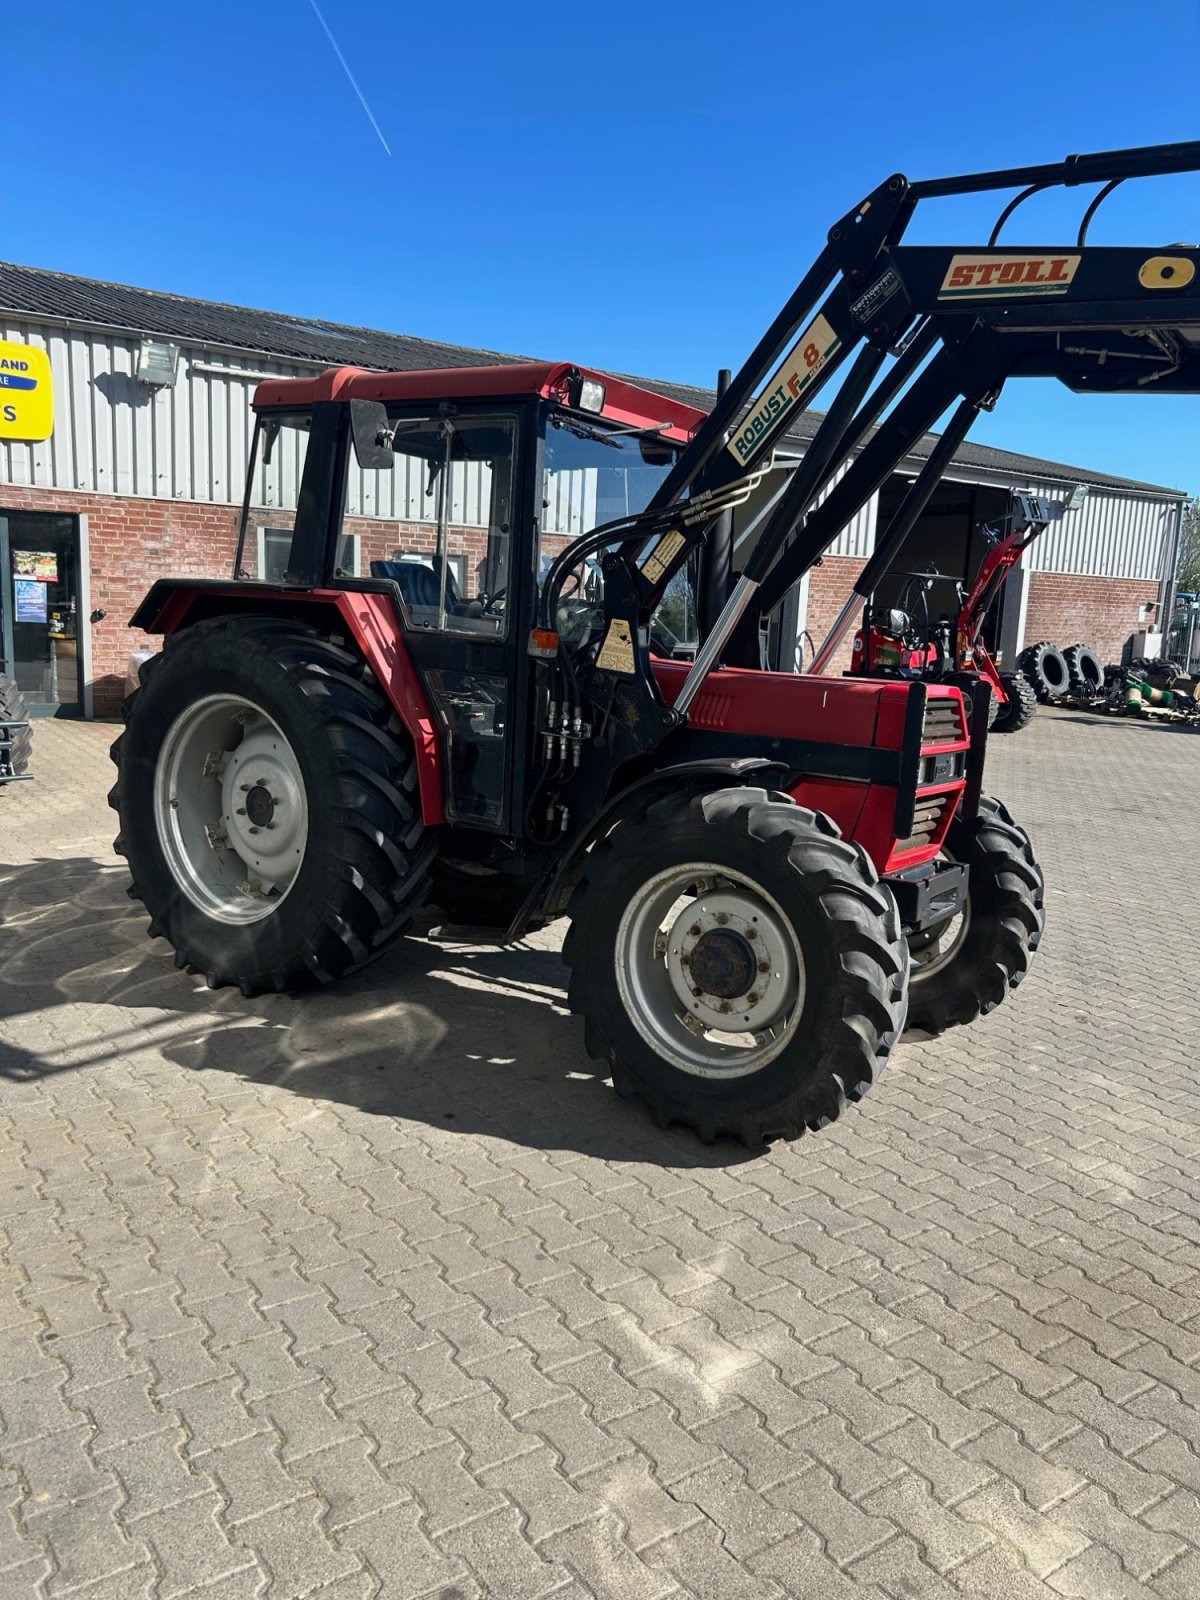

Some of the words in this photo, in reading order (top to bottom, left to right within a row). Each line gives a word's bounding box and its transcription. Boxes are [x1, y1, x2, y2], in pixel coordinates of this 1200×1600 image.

[948, 258, 1069, 287] STOLL
[0, 405, 17, 422] S
[734, 385, 787, 456] ROBUST
[786, 372, 802, 399] F
[803, 343, 820, 368] 8
